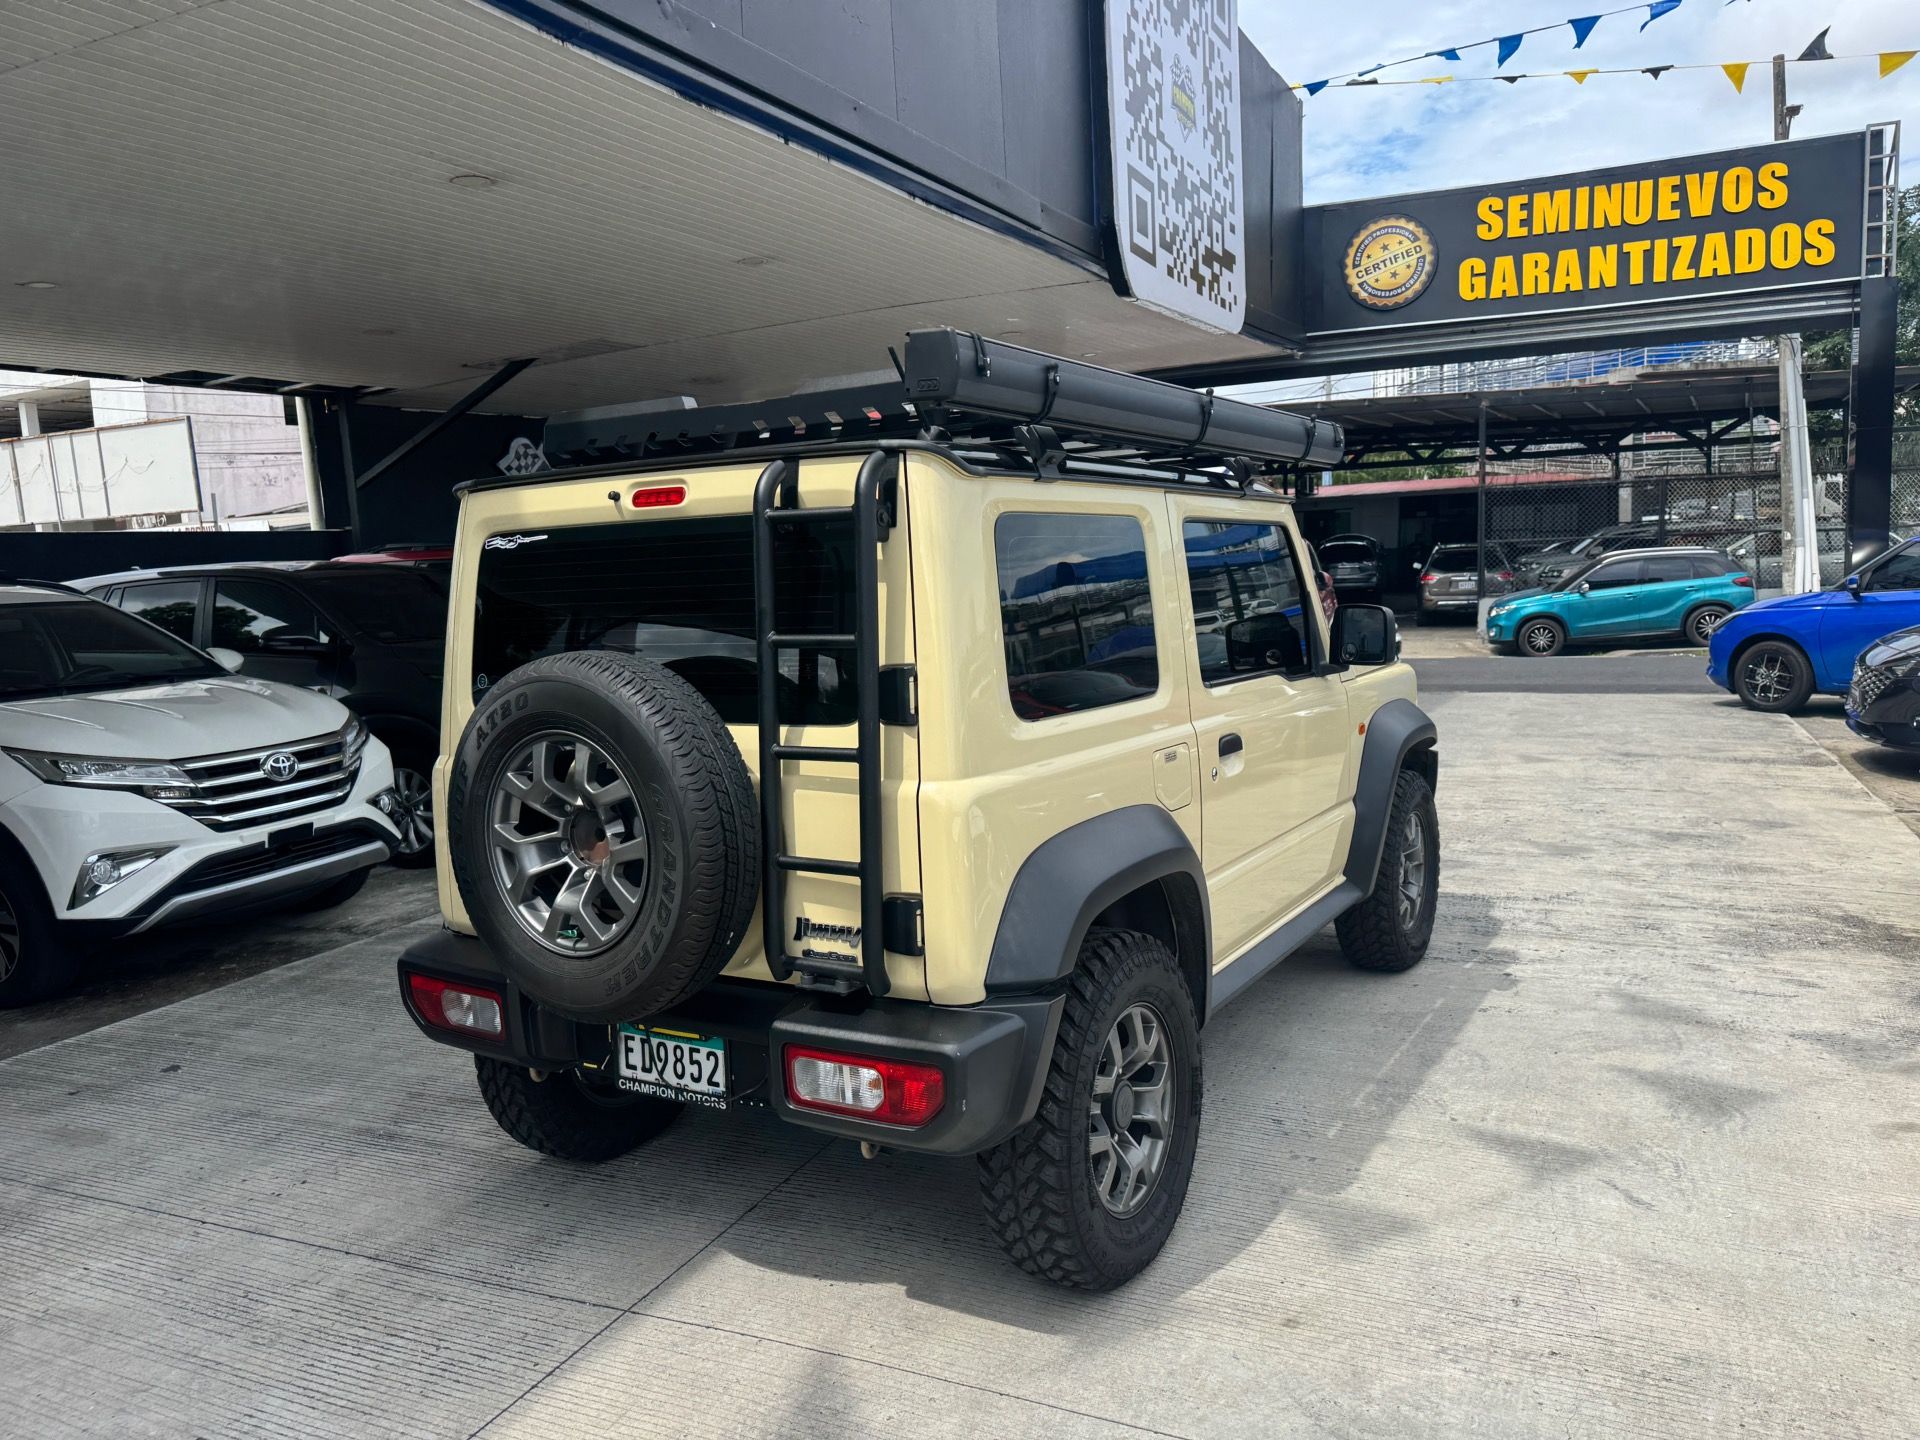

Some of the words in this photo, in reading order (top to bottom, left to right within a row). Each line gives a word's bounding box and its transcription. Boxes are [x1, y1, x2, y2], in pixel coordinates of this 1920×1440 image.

[1476, 162, 1789, 241] SEMINUEVOS
[1354, 235, 1373, 265] CERTIFIED
[1372, 227, 1415, 241] PROFESSIONAL
[1355, 244, 1423, 280] CERTIFIED
[1458, 218, 1836, 301] GARANTIZADOS
[1405, 258, 1424, 288] CERTIFIED
[623, 1033, 721, 1089] ED9852
[618, 1078, 676, 1100] CHAMPION
[678, 1090, 727, 1110] MOTORS
